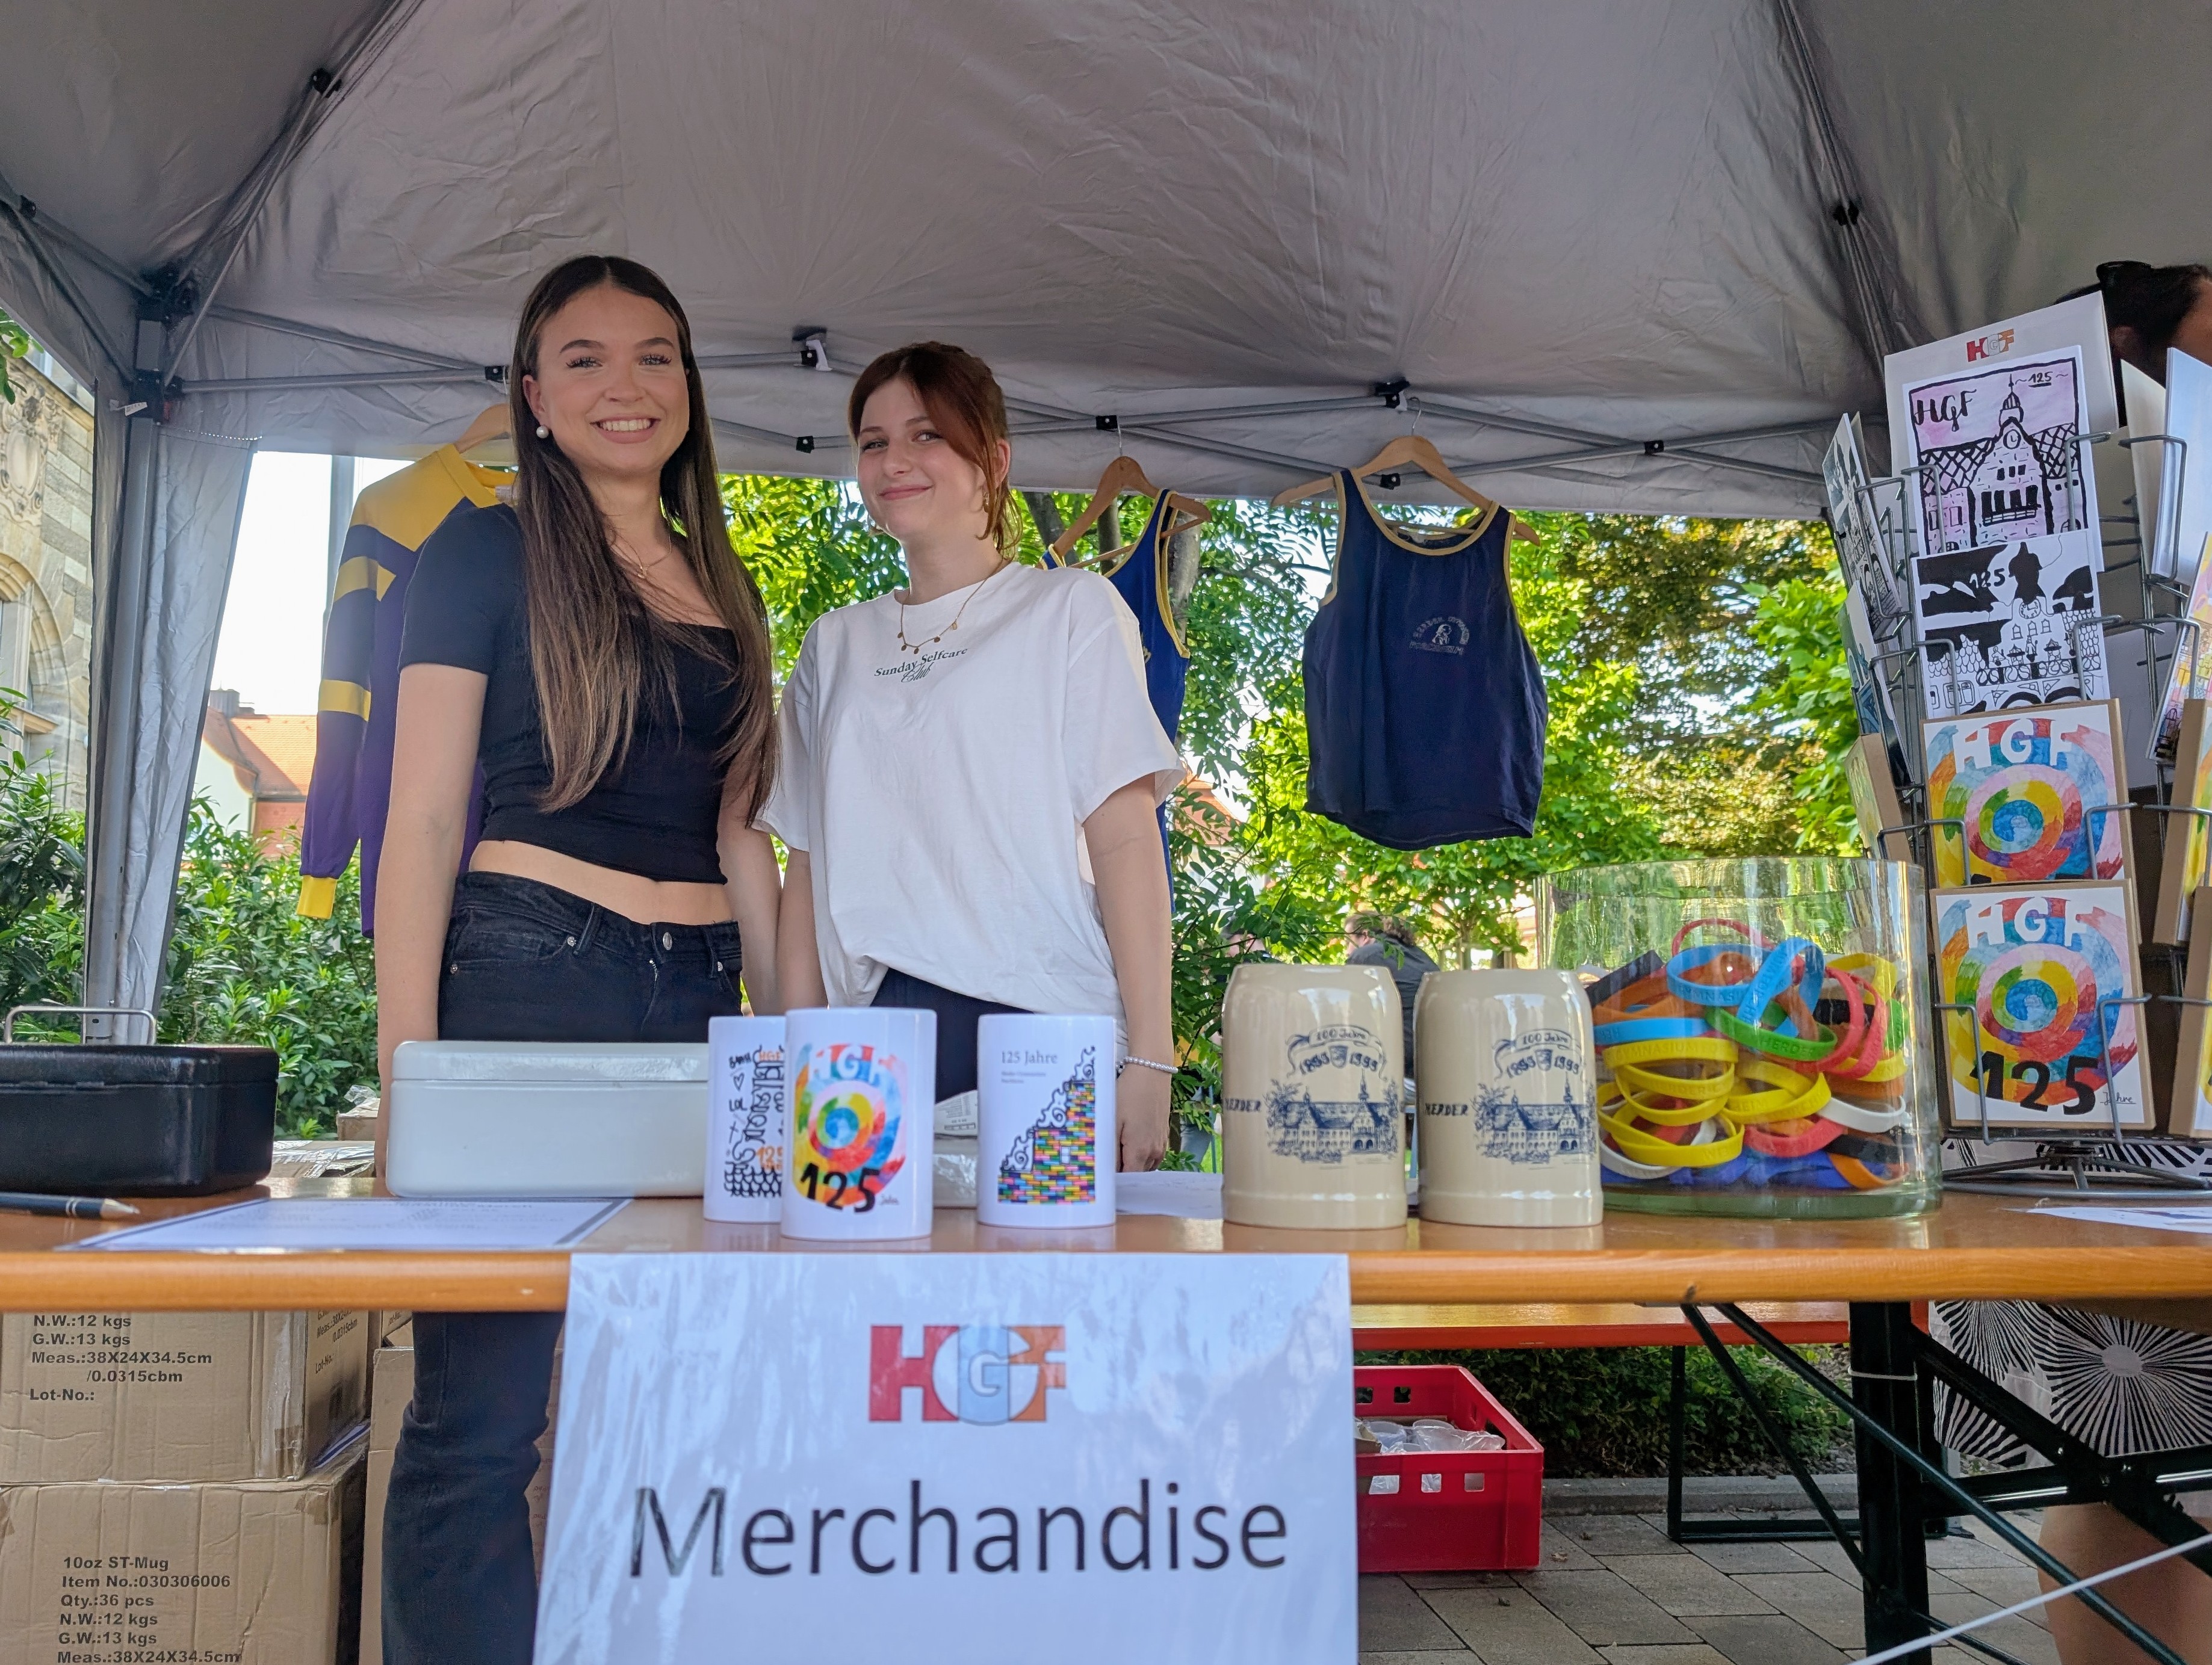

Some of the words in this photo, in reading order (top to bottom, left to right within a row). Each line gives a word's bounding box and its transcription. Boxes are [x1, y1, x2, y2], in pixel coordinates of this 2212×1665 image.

[1912, 389, 1977, 431] HGF
[1969, 568, 2006, 588] 125
[874, 661, 917, 676] Sunday
[921, 648, 968, 664] Selfcare
[1953, 719, 2078, 774] HGF
[1965, 897, 2090, 948] HGF
[1522, 1033, 1541, 1045] 100
[1002, 1051, 1021, 1064] 125
[1024, 1049, 1058, 1066] Jahre
[1969, 1051, 2099, 1115] 125
[2101, 1091, 2134, 1106] Jhre
[800, 1163, 880, 1213] 125
[34, 1315, 96, 1327] N.W.:12
[103, 1315, 131, 1330] kgs
[33, 1333, 96, 1345] G.W.:13
[102, 1333, 131, 1348] kgs
[32, 1351, 212, 1364] Meas.:38X24X34.5cm
[87, 1370, 183, 1383] /0.0315cbm
[869, 1325, 1066, 1426] HGF
[29, 1388, 95, 1401] Lot-No.:
[629, 1478, 1286, 1578] Merchandise
[64, 1557, 102, 1569] 10oz
[108, 1557, 169, 1572] ST-Mug
[63, 1575, 100, 1588] Item
[107, 1575, 231, 1587] No.:030306006
[61, 1595, 119, 1609] Qty.:36
[125, 1596, 154, 1608] pcs
[60, 1613, 123, 1625] N.W.:12
[129, 1613, 158, 1628] kgs
[58, 1632, 122, 1644] G.W.:13
[128, 1632, 157, 1647] kgs
[57, 1651, 241, 1664] Meas.:38X24X34.5cm
